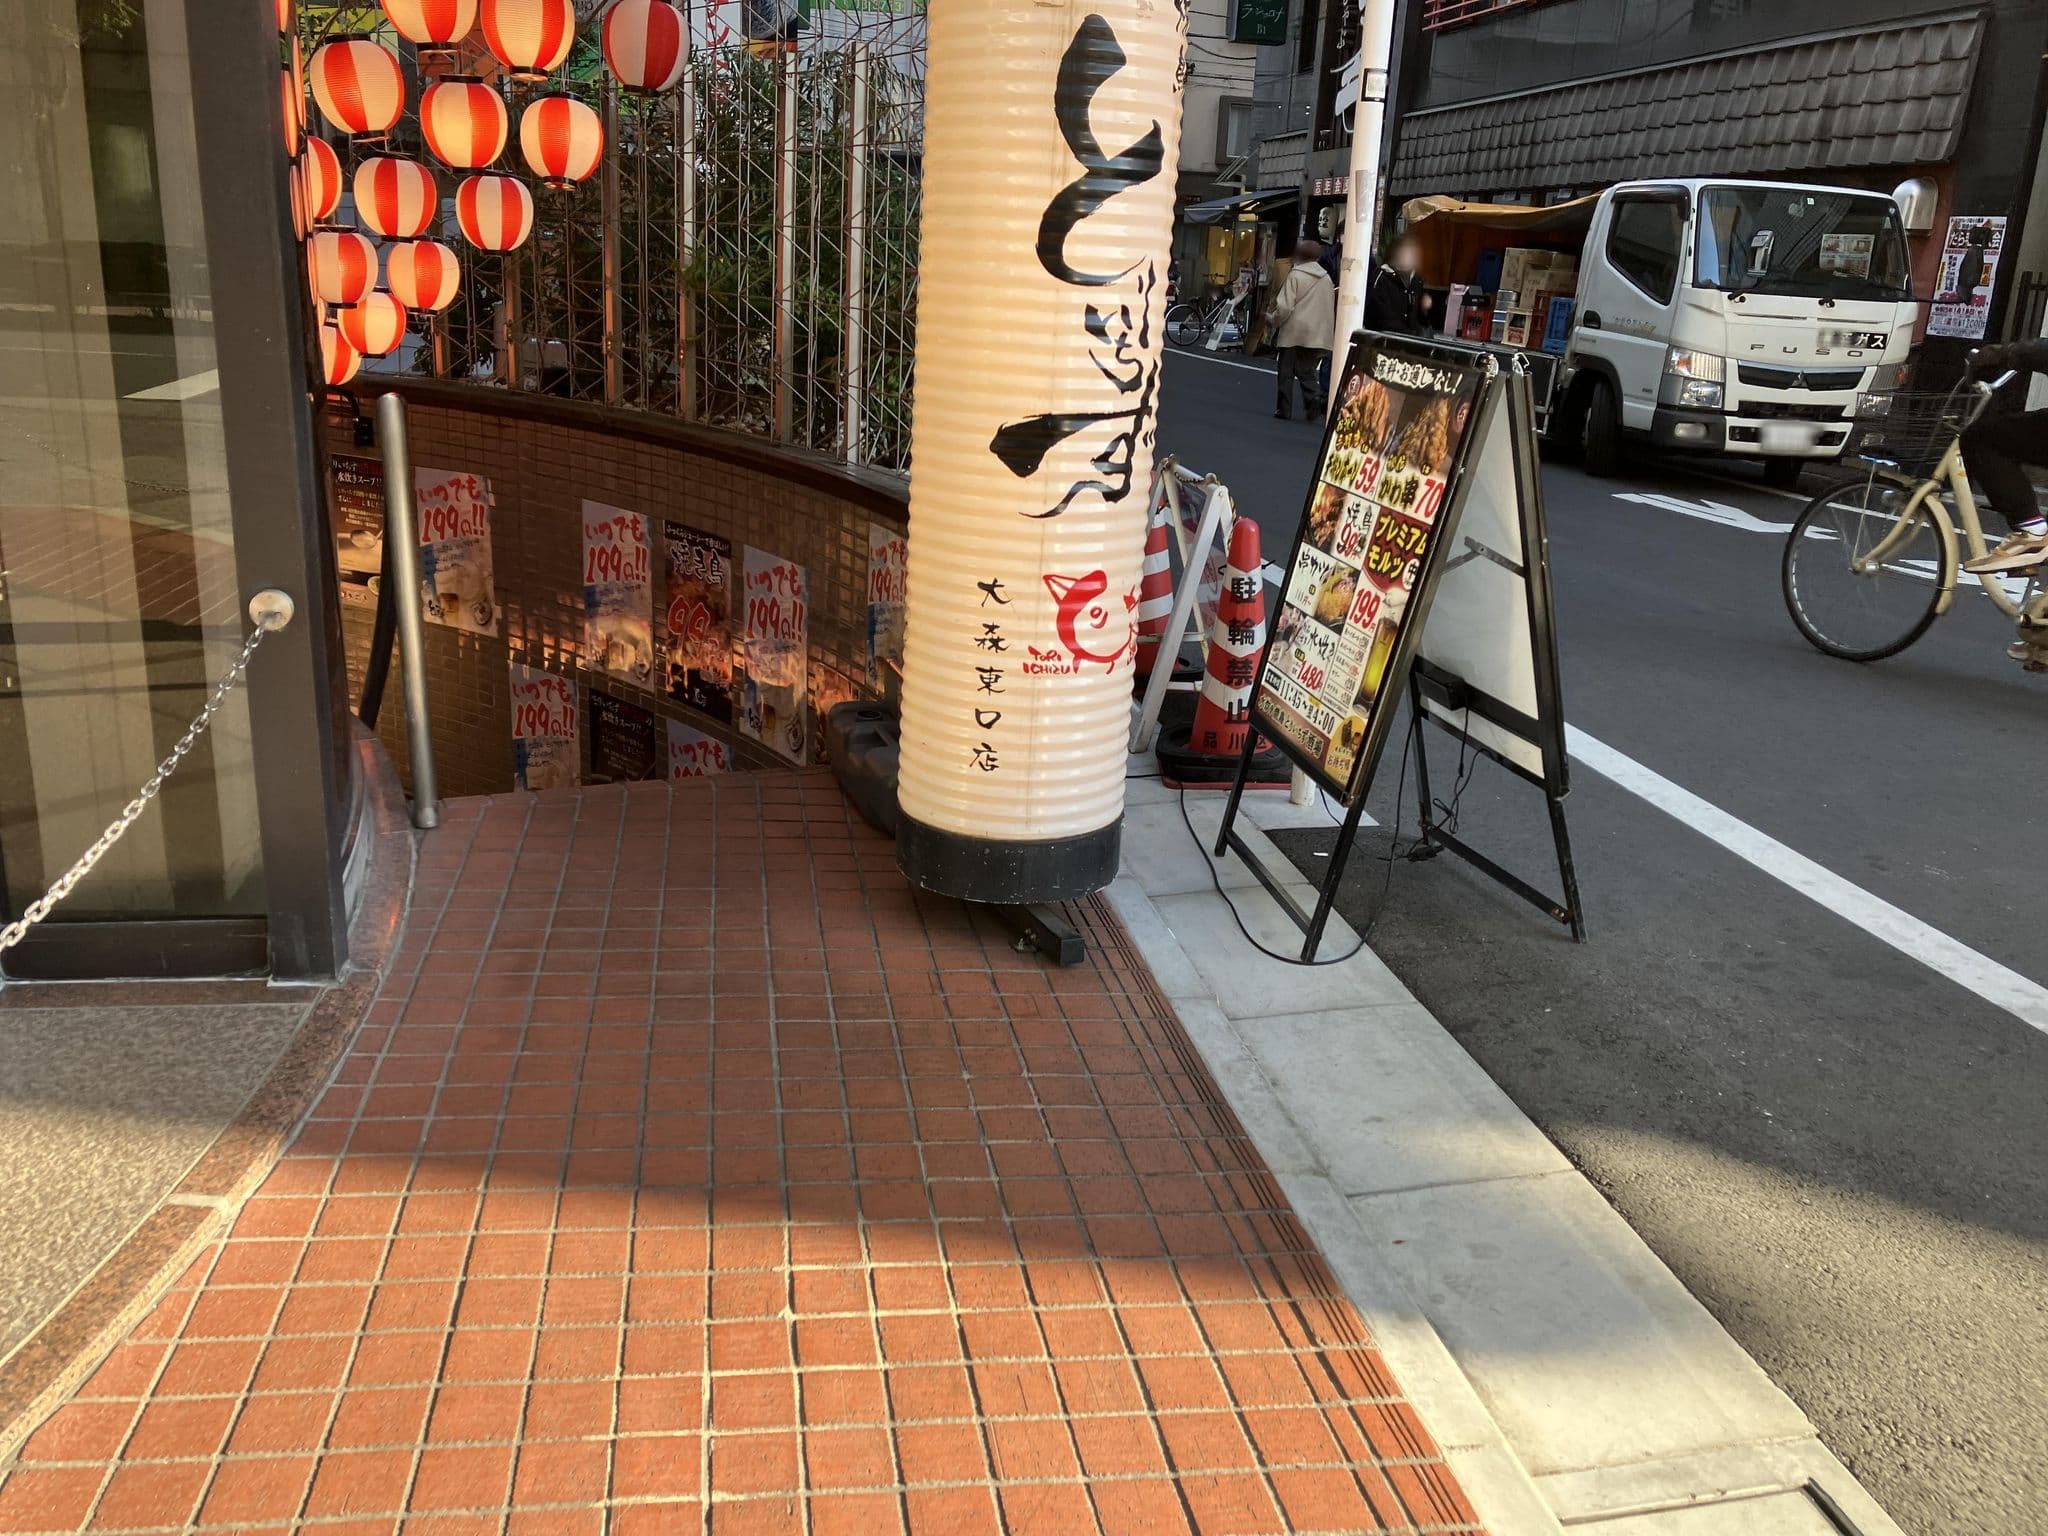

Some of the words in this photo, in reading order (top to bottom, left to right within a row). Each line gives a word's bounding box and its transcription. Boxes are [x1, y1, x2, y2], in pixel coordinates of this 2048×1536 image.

[1750, 343, 1863, 358] FUSO
[417, 473, 482, 502] いつでも
[584, 512, 644, 543] いつでも
[1376, 515, 1429, 557] プレミアム
[1368, 545, 1405, 580] モルツ
[746, 564, 802, 597] いつでも
[1225, 576, 1257, 726] 駐輪禁止
[512, 677, 571, 702] いつでも
[968, 577, 1014, 773] 大森東口店
[670, 740, 727, 770] いつでも
